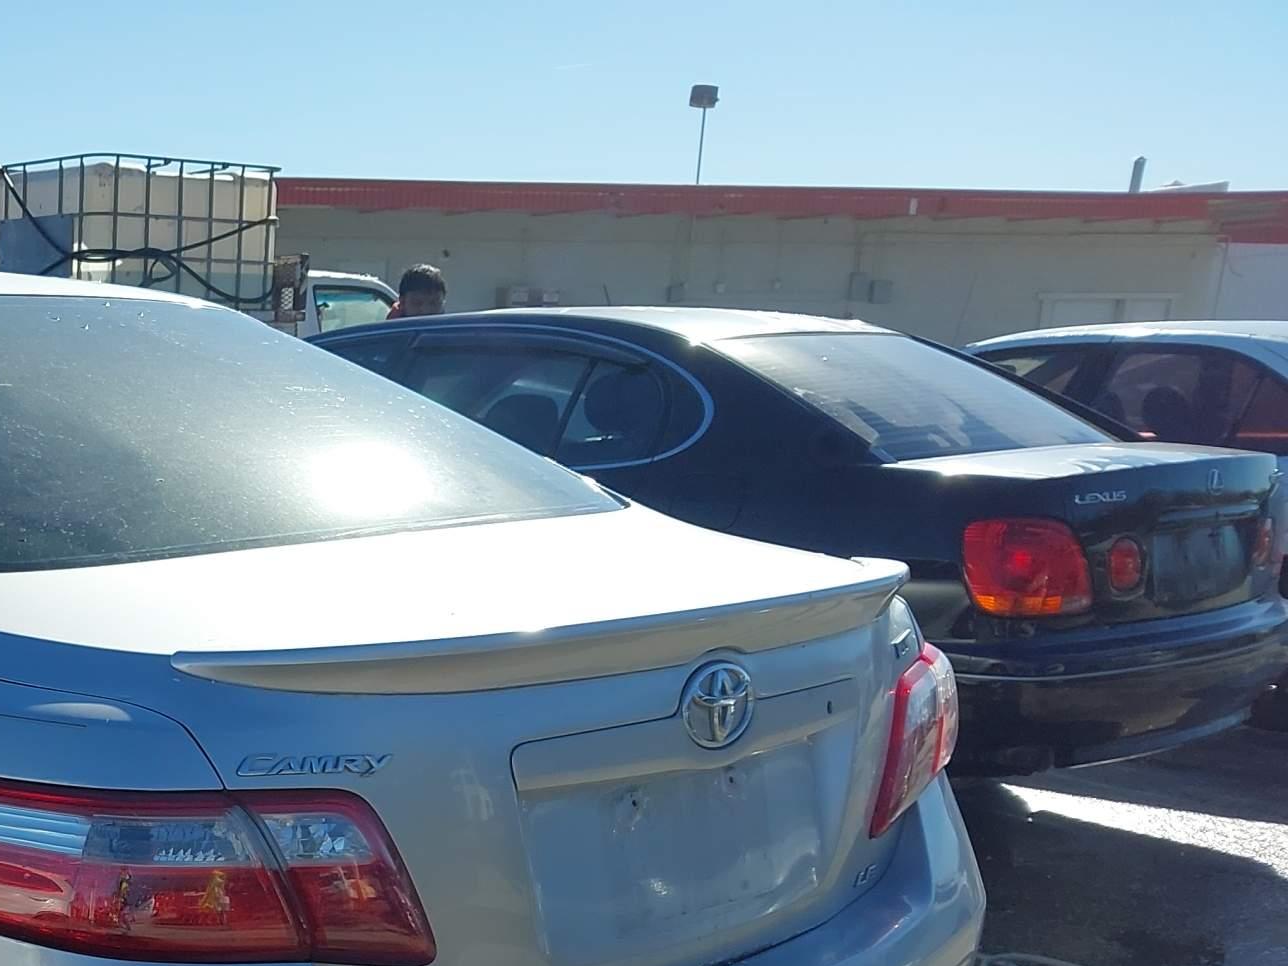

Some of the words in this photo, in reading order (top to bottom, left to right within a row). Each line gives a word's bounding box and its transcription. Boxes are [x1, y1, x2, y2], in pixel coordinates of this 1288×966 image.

[1074, 490, 1128, 504] LEXUS
[236, 752, 394, 778] CAMRY
[853, 863, 877, 888] LE
